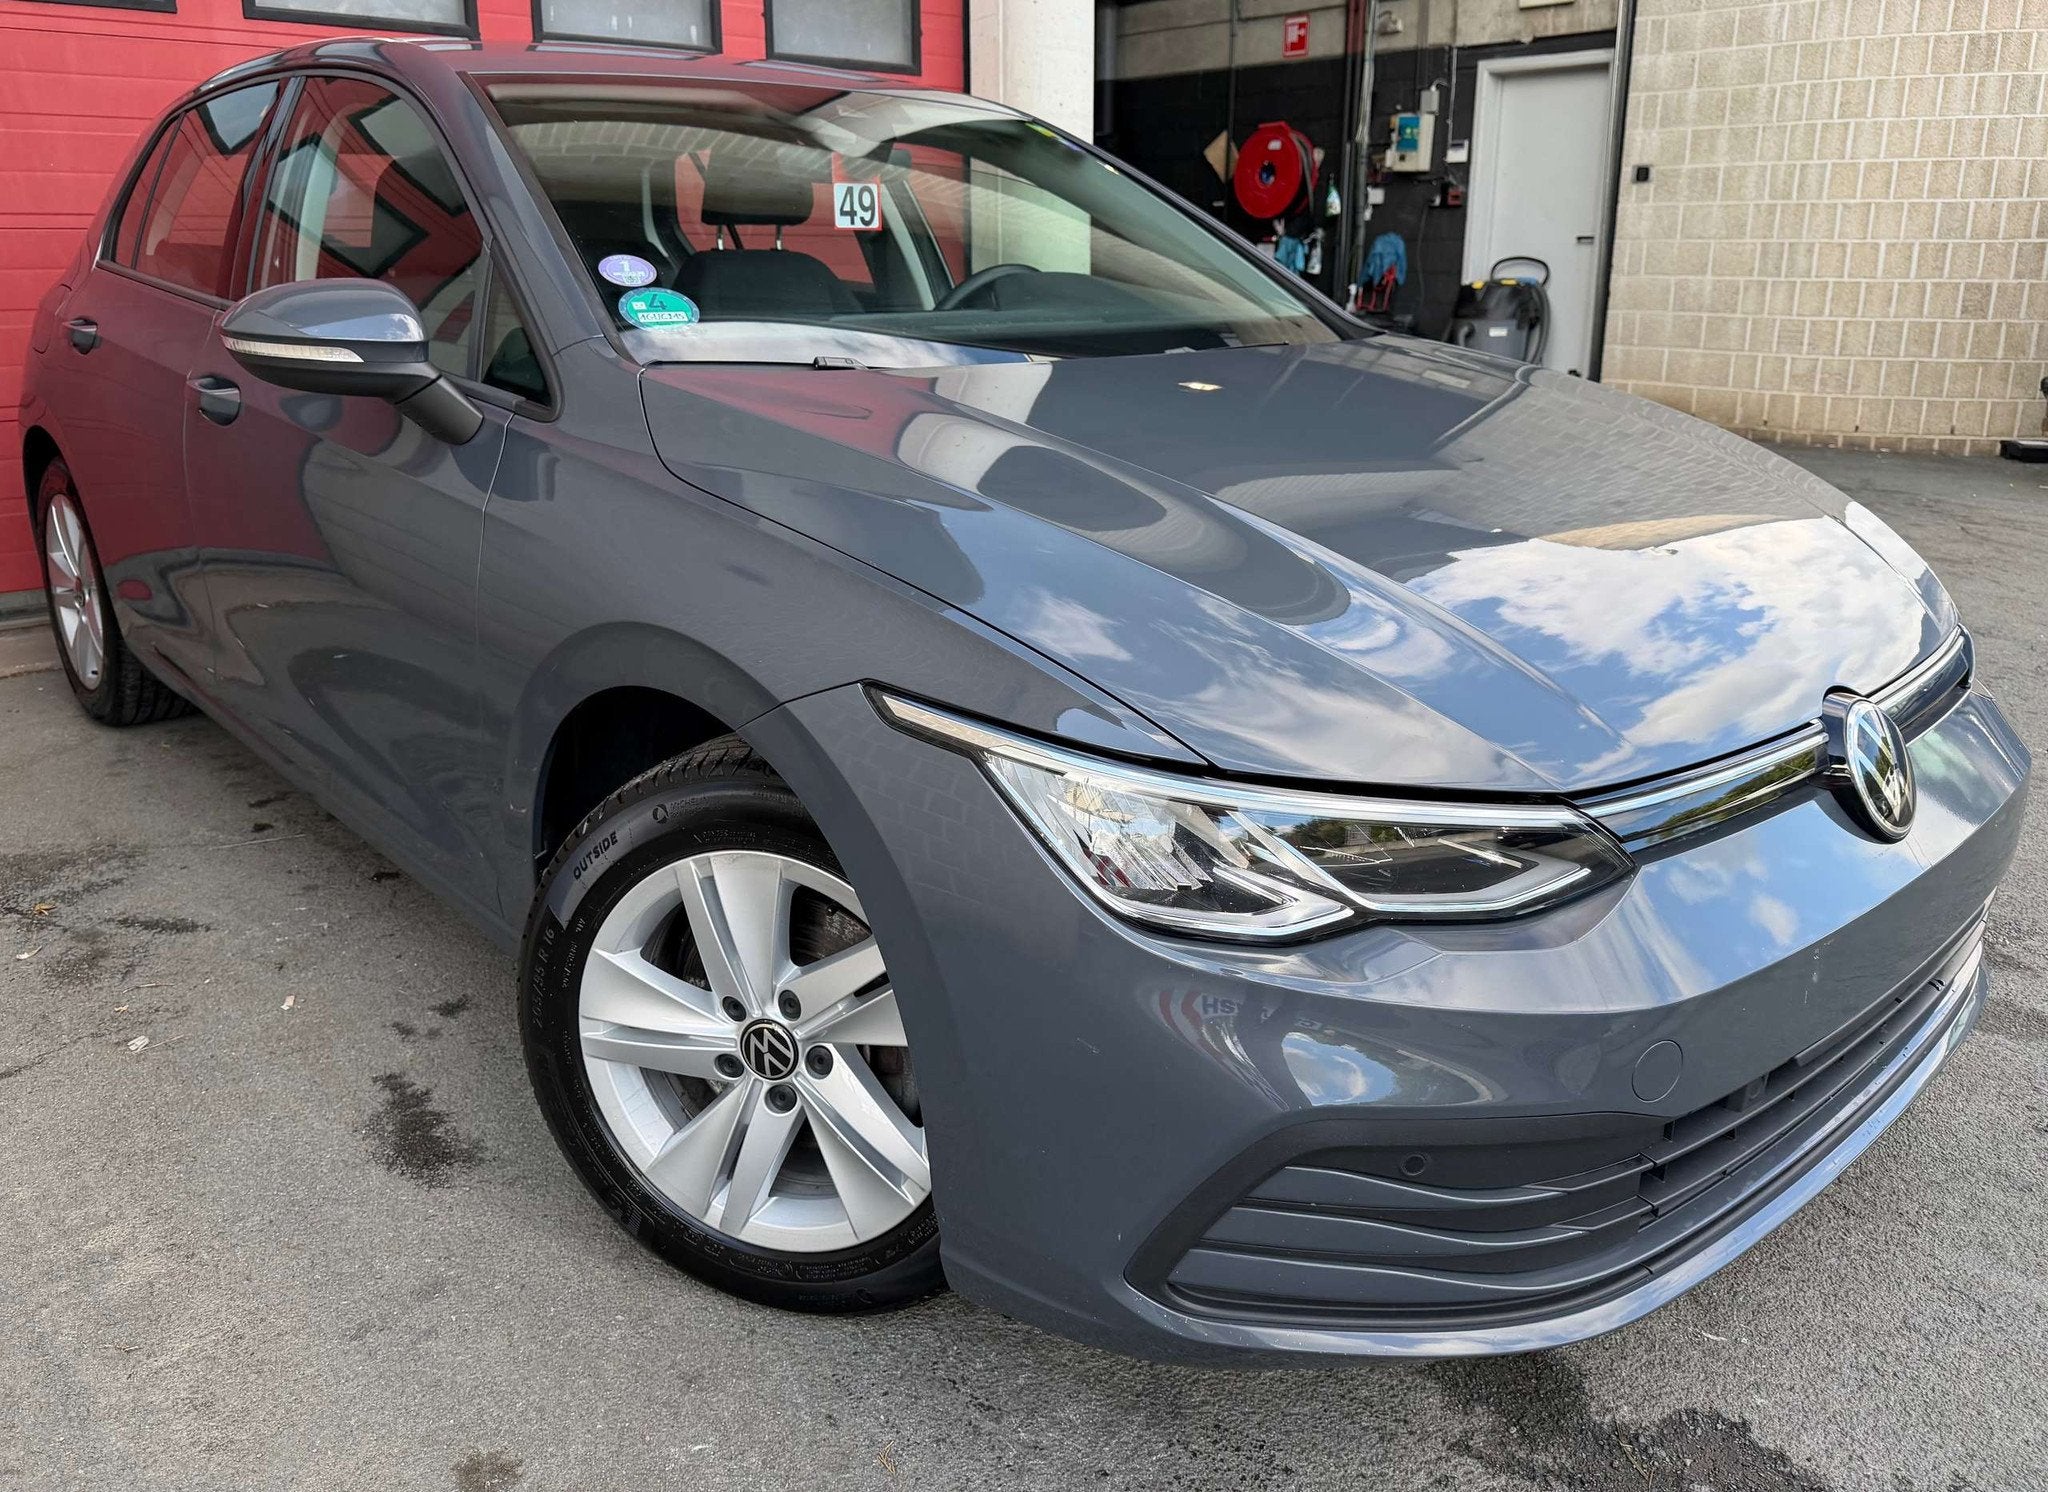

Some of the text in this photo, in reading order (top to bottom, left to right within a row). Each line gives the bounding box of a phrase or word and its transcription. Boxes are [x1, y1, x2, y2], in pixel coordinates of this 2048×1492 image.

[839, 185, 876, 227] 49
[648, 293, 669, 311] 4
[572, 830, 620, 881] OUTSIDE
[538, 949, 550, 964] R
[544, 926, 557, 946] 16
